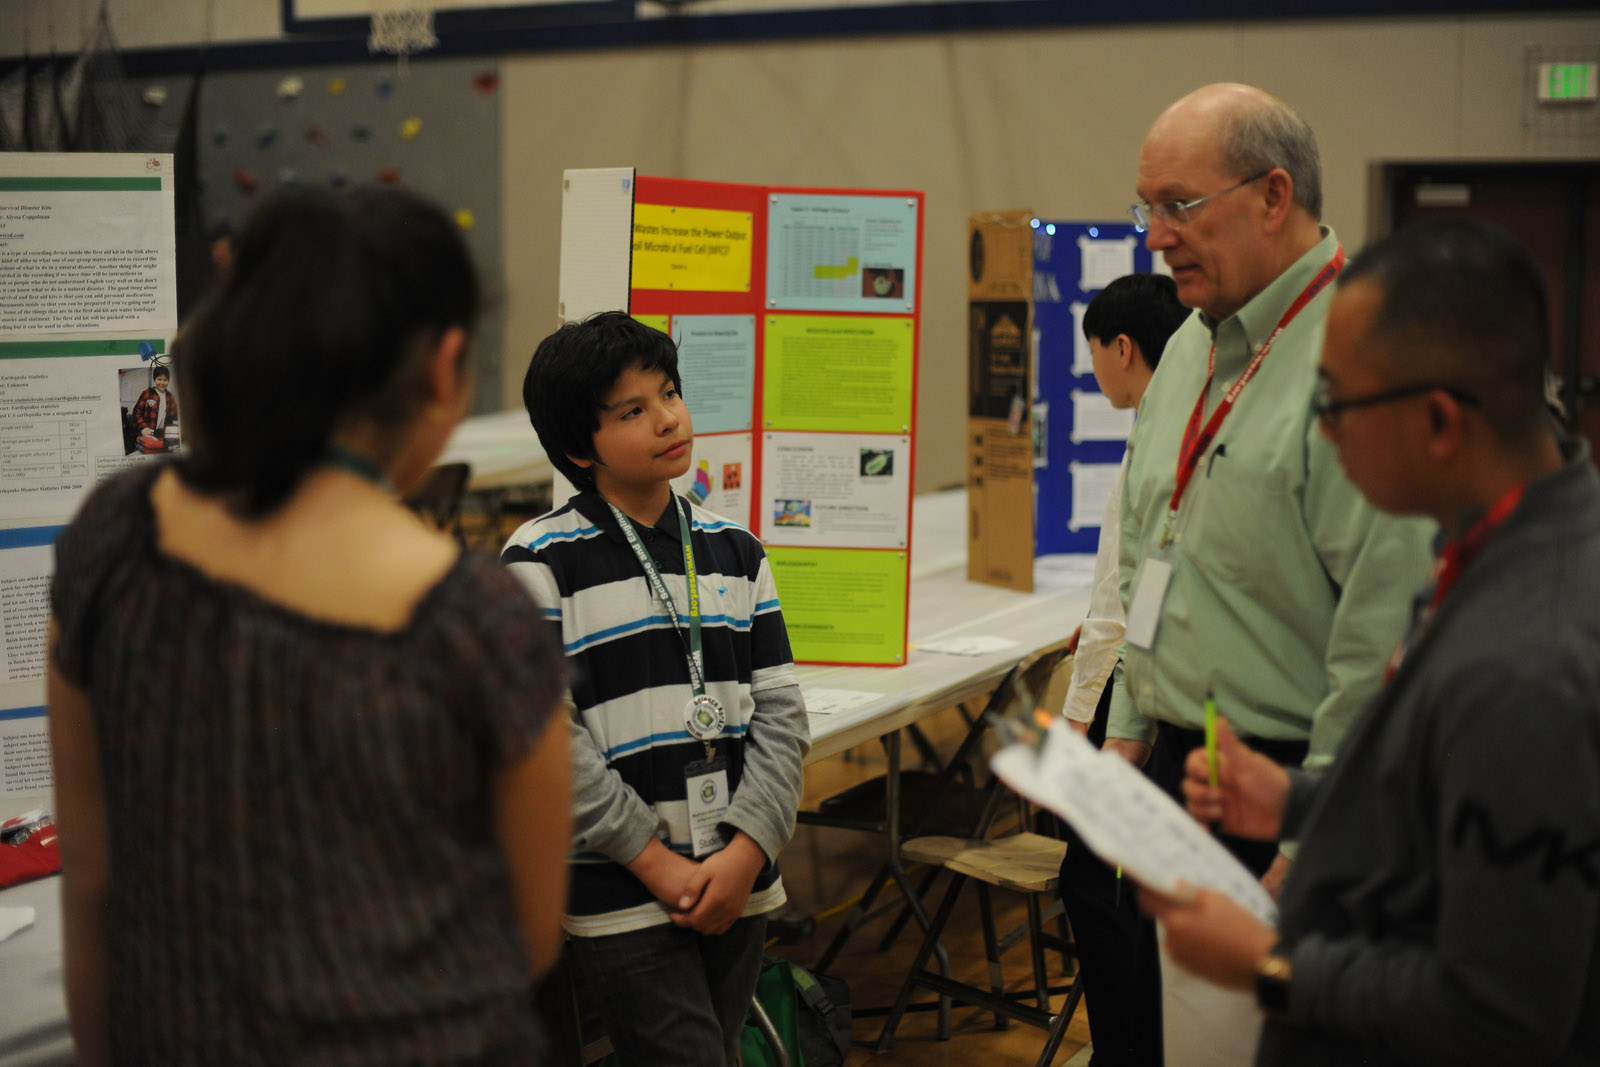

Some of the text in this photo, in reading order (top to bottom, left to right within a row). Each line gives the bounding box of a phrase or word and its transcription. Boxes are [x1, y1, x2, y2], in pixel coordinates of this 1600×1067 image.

[1549, 64, 1590, 98] EXIT
[632, 542, 648, 561] and
[644, 561, 669, 600] Science
[685, 544, 700, 617] www.wssef.org
